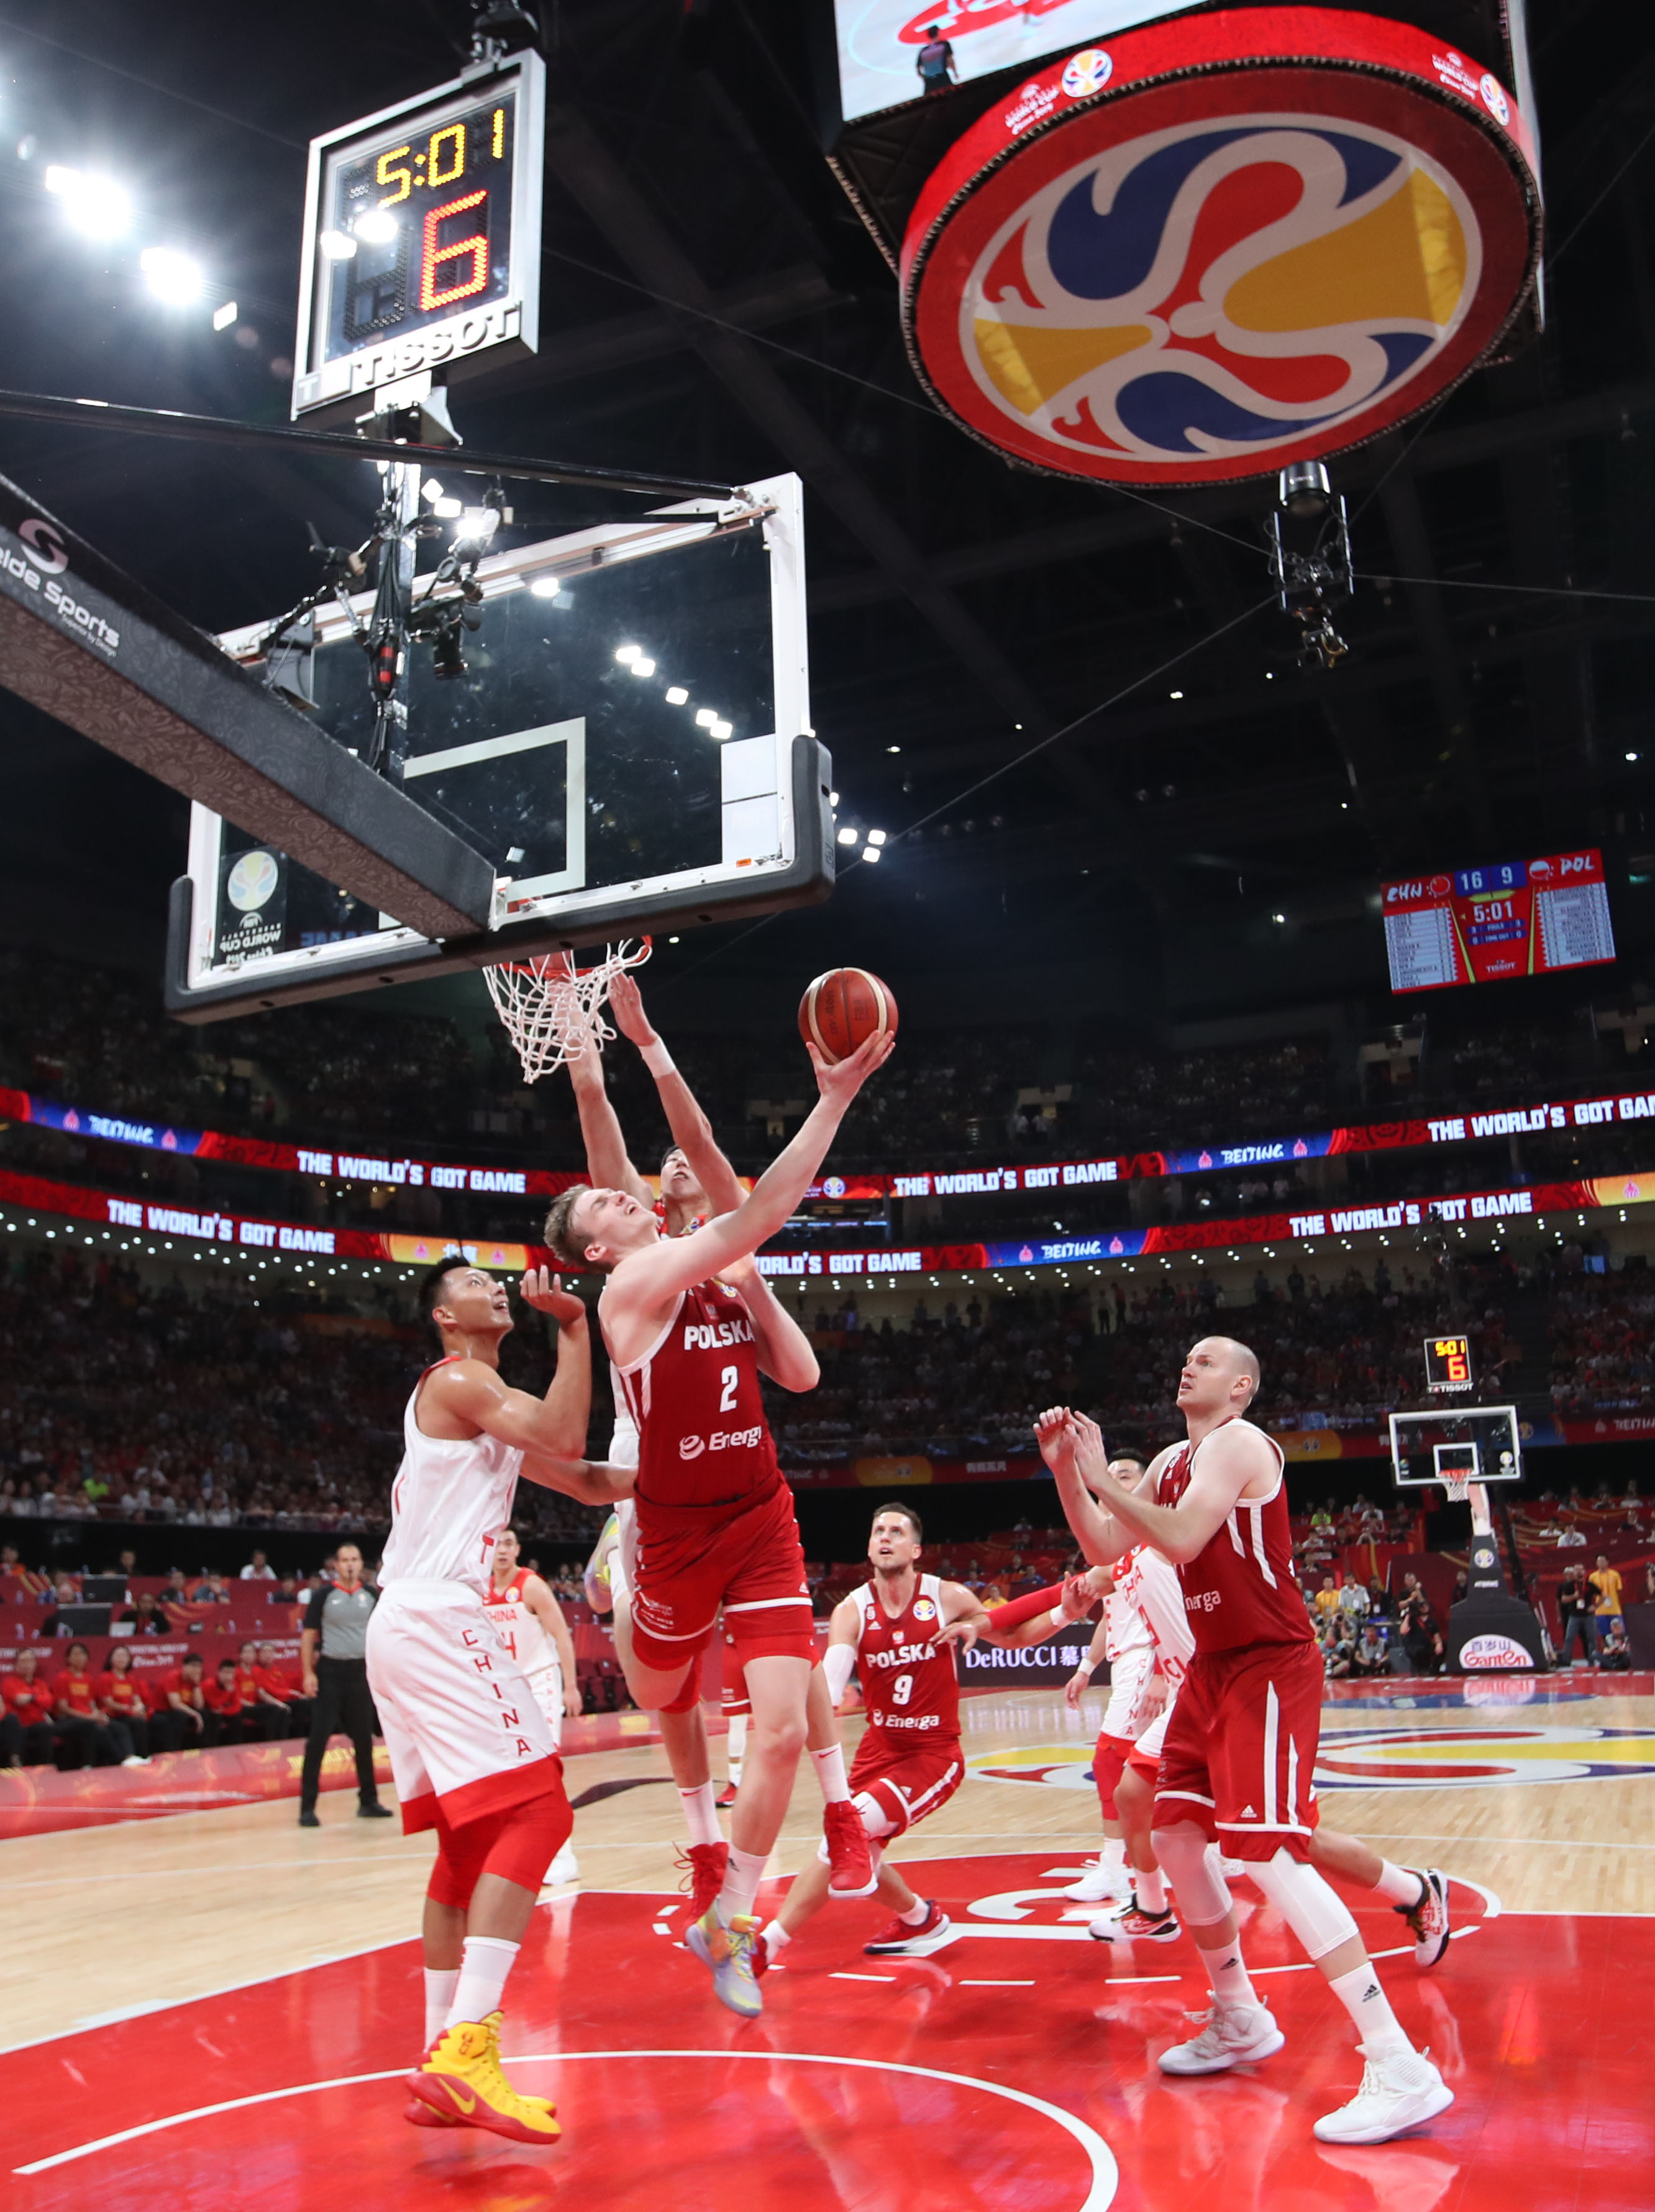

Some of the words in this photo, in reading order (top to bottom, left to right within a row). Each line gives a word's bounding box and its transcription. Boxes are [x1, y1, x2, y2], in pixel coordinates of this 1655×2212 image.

[376, 109, 504, 209] 5:01
[421, 190, 488, 311] 6
[352, 304, 519, 385] TISSOT
[43, 580, 120, 648] Sports
[1387, 883, 1423, 902] CHN
[1461, 871, 1483, 890] 16
[1501, 866, 1513, 885] 9
[1559, 855, 1595, 875] POL
[1473, 900, 1513, 923] 5:01
[1486, 962, 1516, 973] TISSOT
[1428, 1118, 1466, 1142] THE
[1470, 1103, 1566, 1137] WORLD'S
[1574, 1100, 1614, 1125] GOT
[297, 1150, 333, 1176] THE
[337, 1156, 424, 1186] WORLD'S
[431, 1166, 467, 1189] GOT
[470, 1170, 526, 1194] GAME
[893, 1176, 930, 1197] THE
[934, 1167, 1017, 1195] WORLD'S
[1024, 1167, 1059, 1188] GOT
[1063, 1161, 1118, 1185] GAME
[107, 1199, 143, 1228] THE
[147, 1206, 234, 1241] WORLD'S
[240, 1222, 277, 1247] GOT
[278, 1227, 335, 1255] GAME
[1289, 1215, 1326, 1237] THE
[1330, 1200, 1421, 1233] WORLD'S
[1470, 1192, 1533, 1218] GAME
[829, 1254, 864, 1274] GOT
[867, 1251, 922, 1273] GAME
[684, 1320, 756, 1351] POLSKA
[1448, 1355, 1468, 1382] 6
[719, 1365, 739, 1413] 2
[1441, 1382, 1474, 1393] TISSOT
[708, 1425, 762, 1451] Energ
[865, 1642, 937, 1668] POLSKA
[965, 1646, 1057, 1668] DeRUCCI
[462, 1629, 532, 1757] CHINA
[892, 1675, 914, 1706] 9
[885, 1714, 941, 1730] Energa
